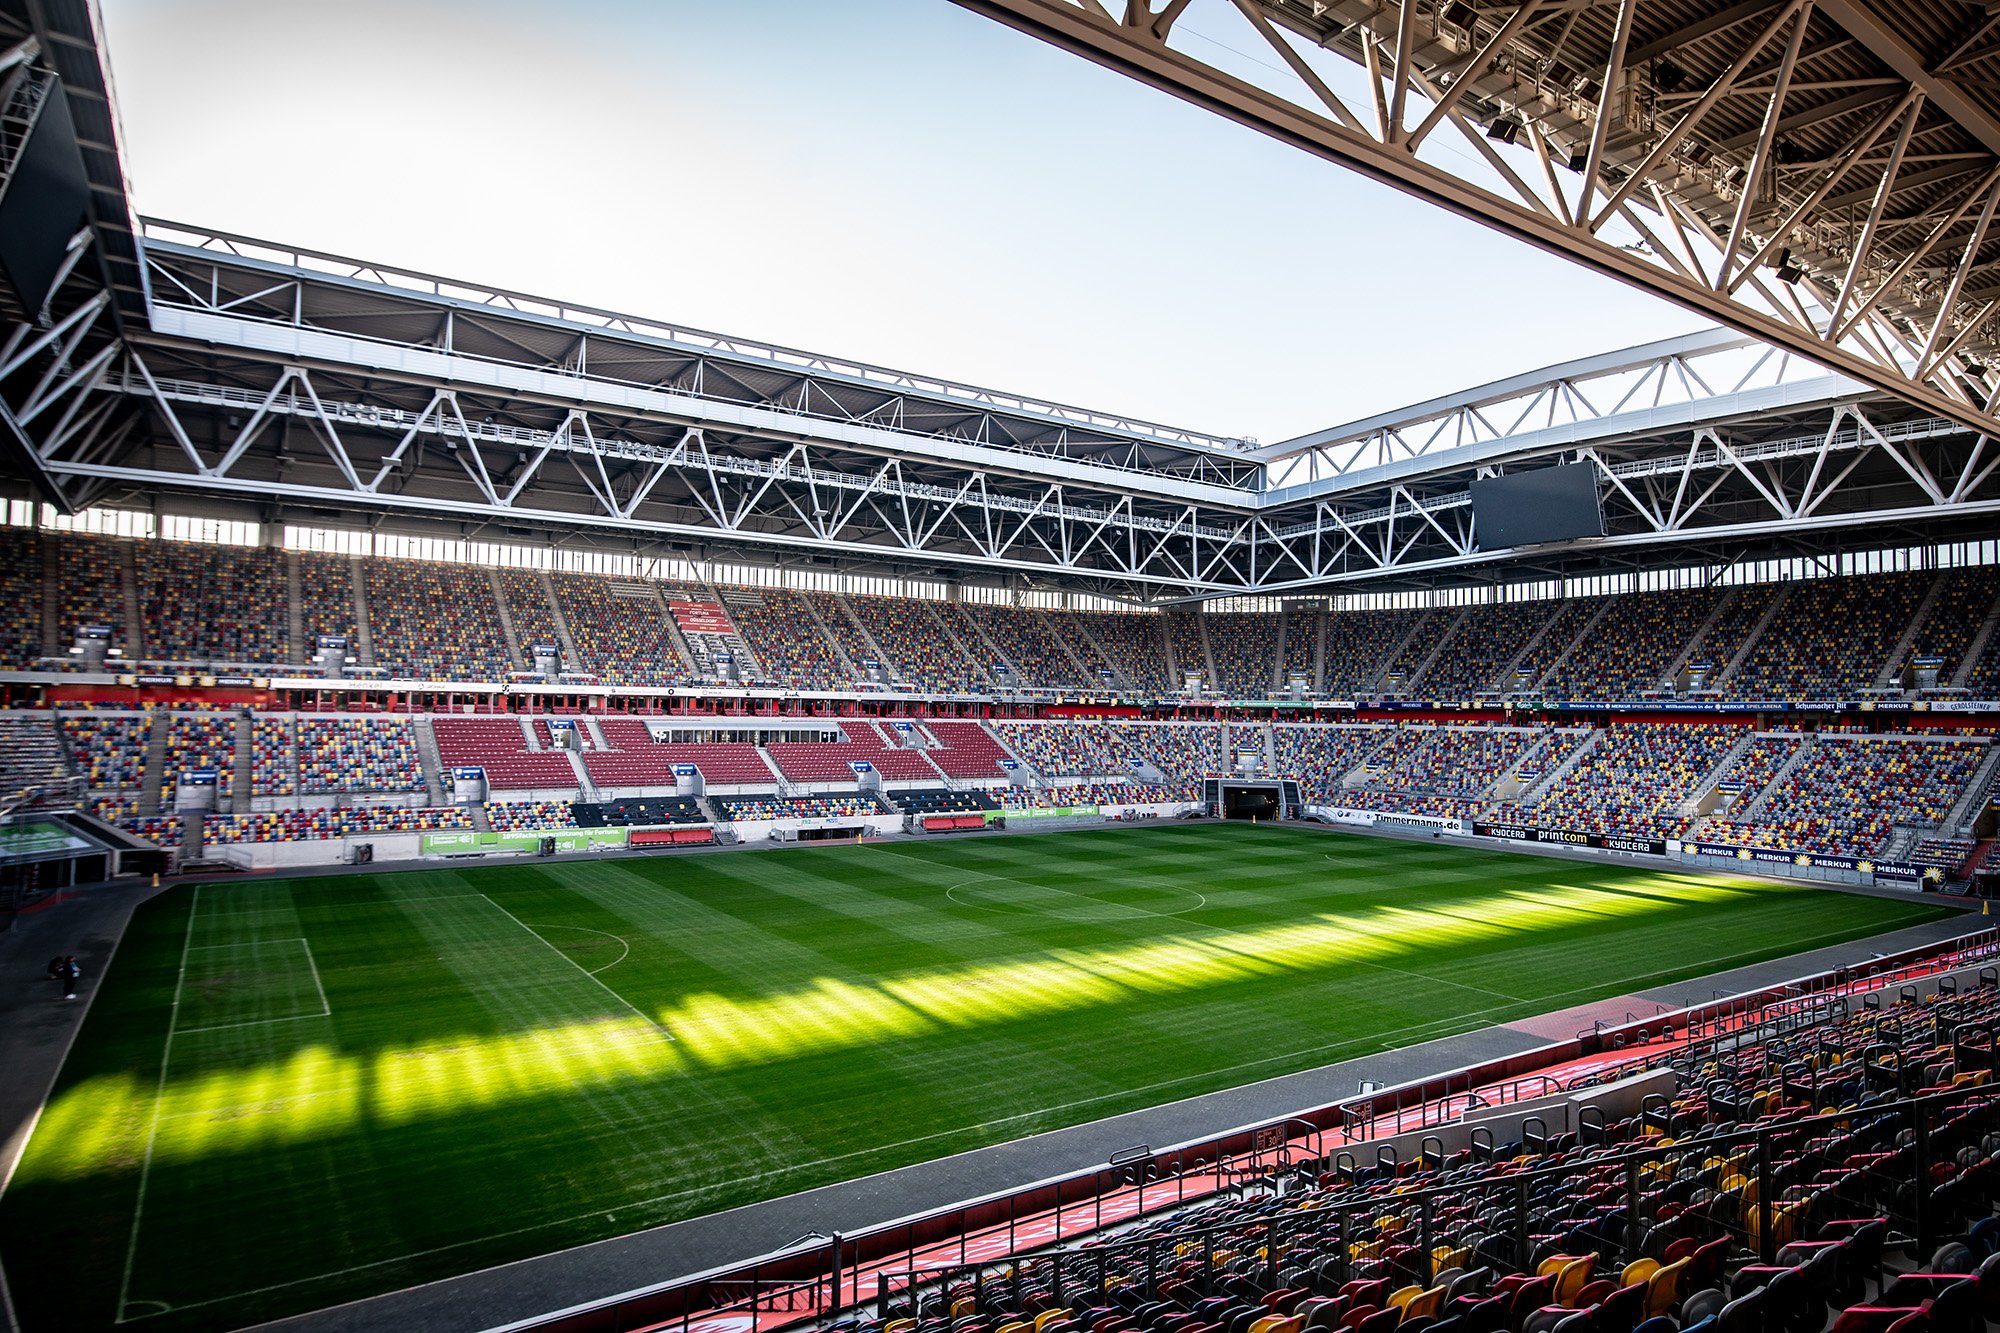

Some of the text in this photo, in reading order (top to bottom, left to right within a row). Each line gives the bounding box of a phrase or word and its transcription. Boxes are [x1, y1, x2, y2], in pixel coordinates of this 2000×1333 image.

[1795, 702, 1834, 710] Schumacher
[1950, 702, 1991, 711] GEROLSTEINER
[1375, 813, 1460, 830] Timmermanns.de
[1538, 830, 1588, 843] printcom
[1701, 847, 1734, 857] MERKUR
[1756, 853, 1791, 863] MERKUR
[1814, 859, 1852, 869] MERKUR
[1877, 865, 1917, 876] MERKUR
